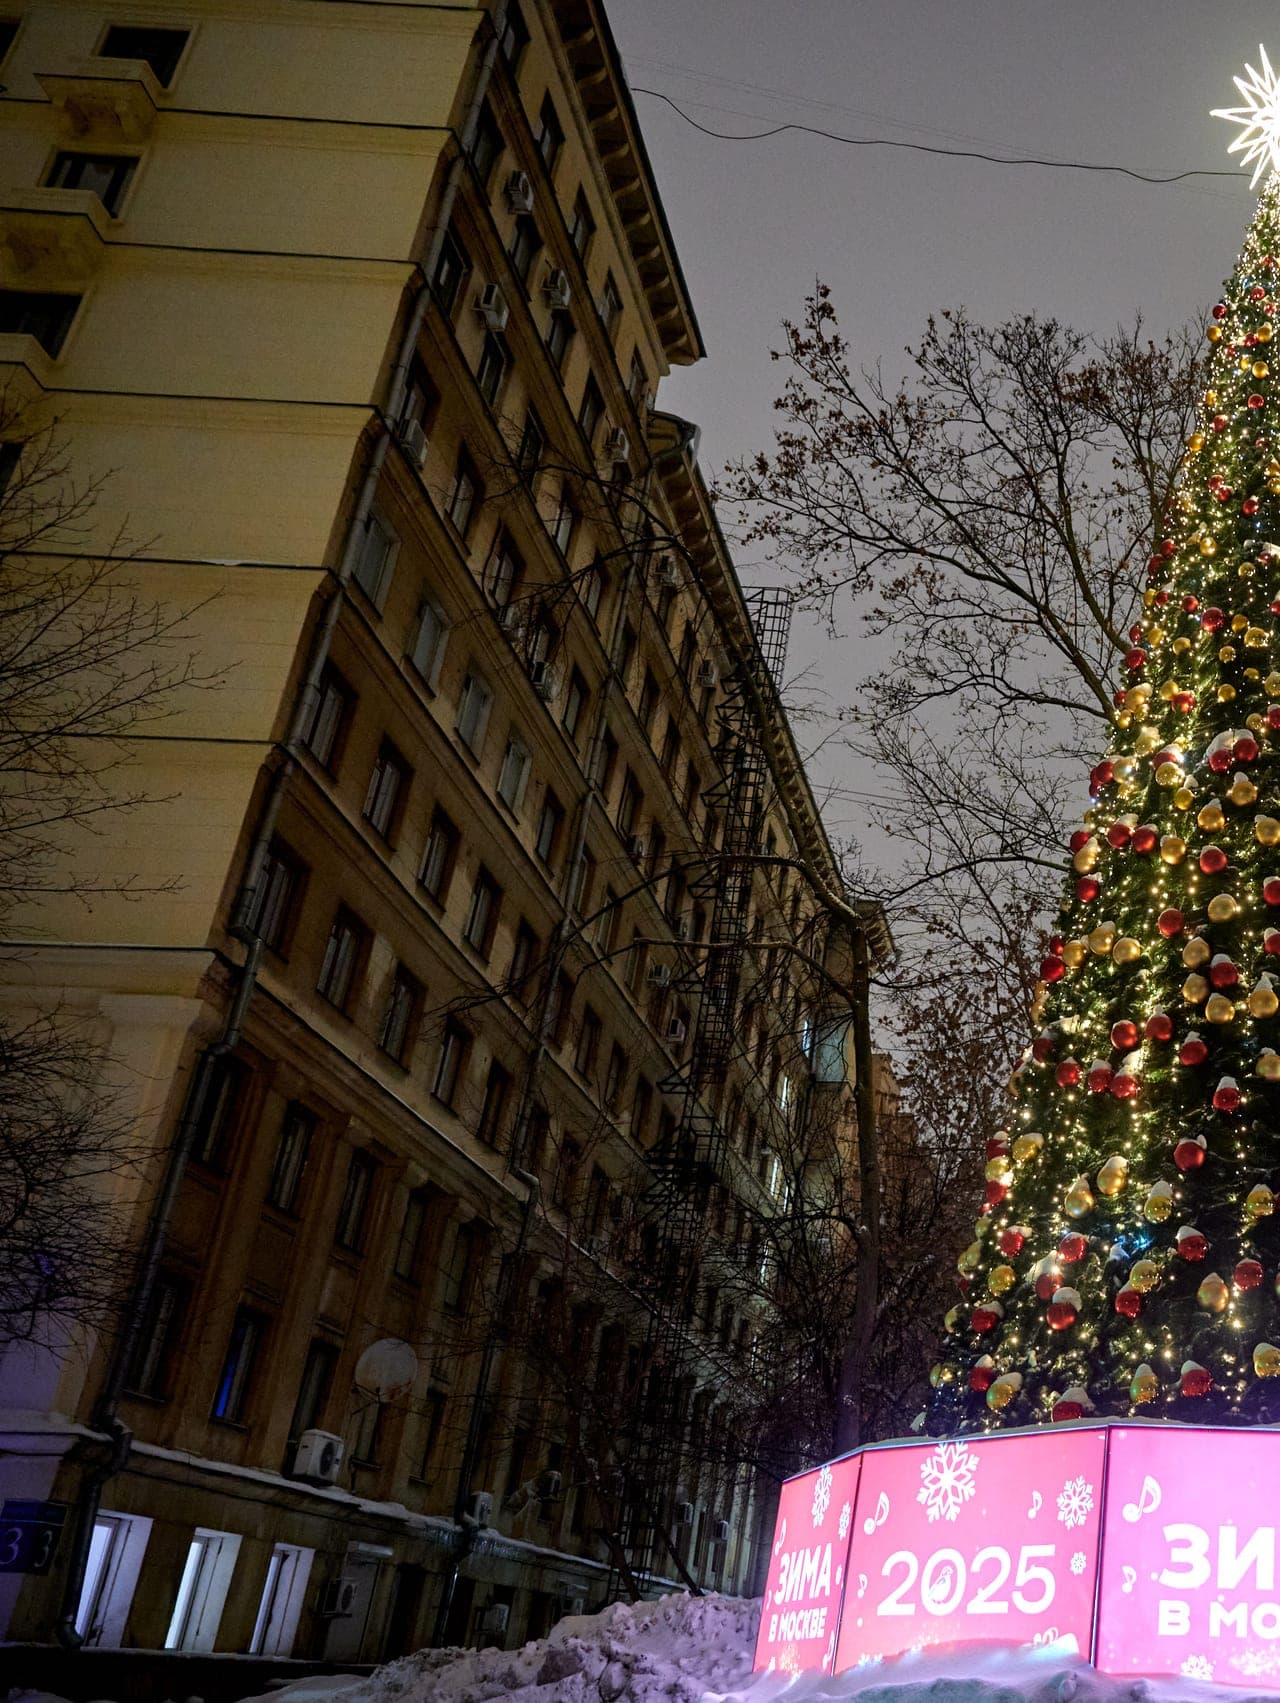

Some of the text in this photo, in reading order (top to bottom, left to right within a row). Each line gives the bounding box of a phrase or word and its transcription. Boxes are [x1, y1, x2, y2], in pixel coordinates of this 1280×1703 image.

[775, 1543, 832, 1605] ЗИМА
[877, 1544, 1056, 1616] 2025
[768, 1607, 826, 1643] В МОСКВЕ
[1158, 1600, 1191, 1636] В
